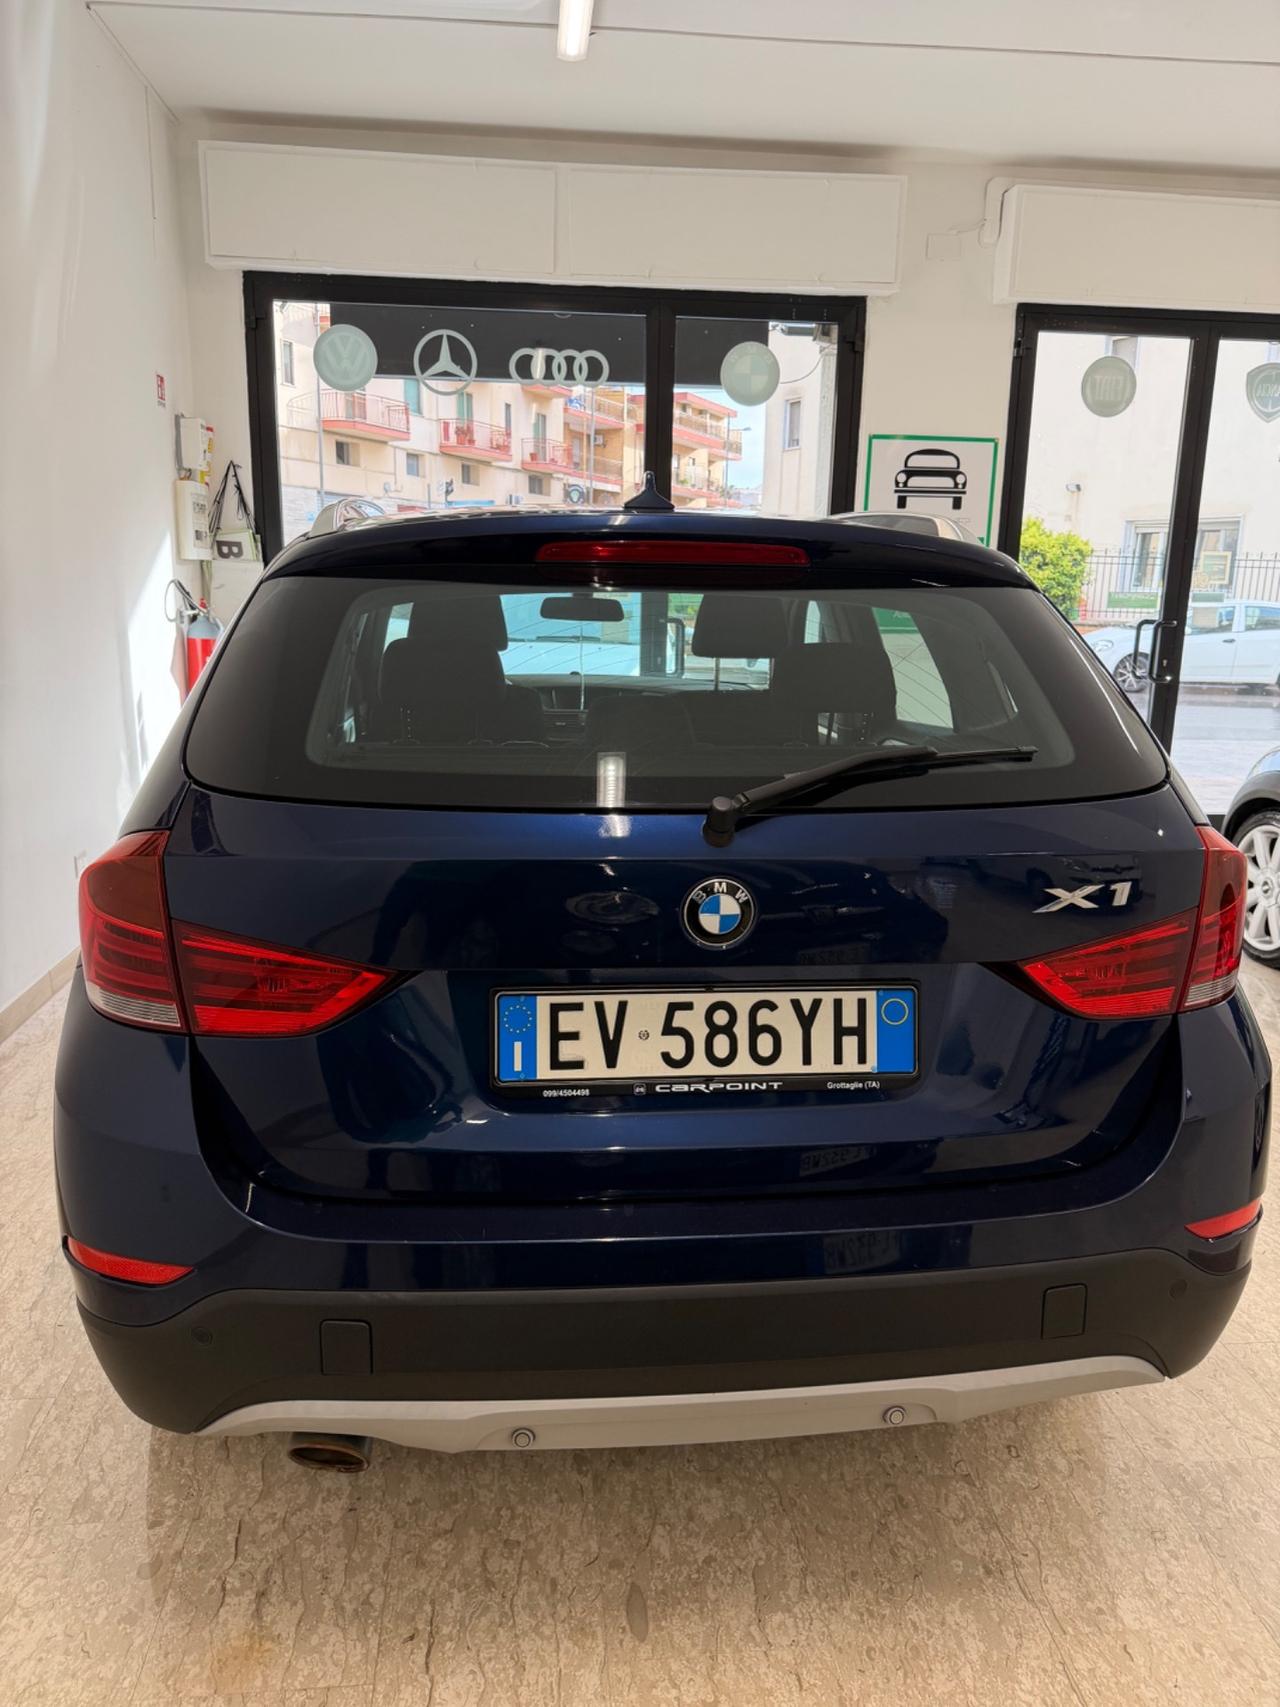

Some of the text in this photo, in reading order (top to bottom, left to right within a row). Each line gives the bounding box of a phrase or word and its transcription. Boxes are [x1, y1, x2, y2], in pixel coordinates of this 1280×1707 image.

[216, 540, 244, 559] B
[693, 882, 749, 904] BMW
[1032, 881, 1132, 913] X1
[549, 1000, 628, 1070] EV
[826, 1080, 880, 1090] Grottaglie (TA)
